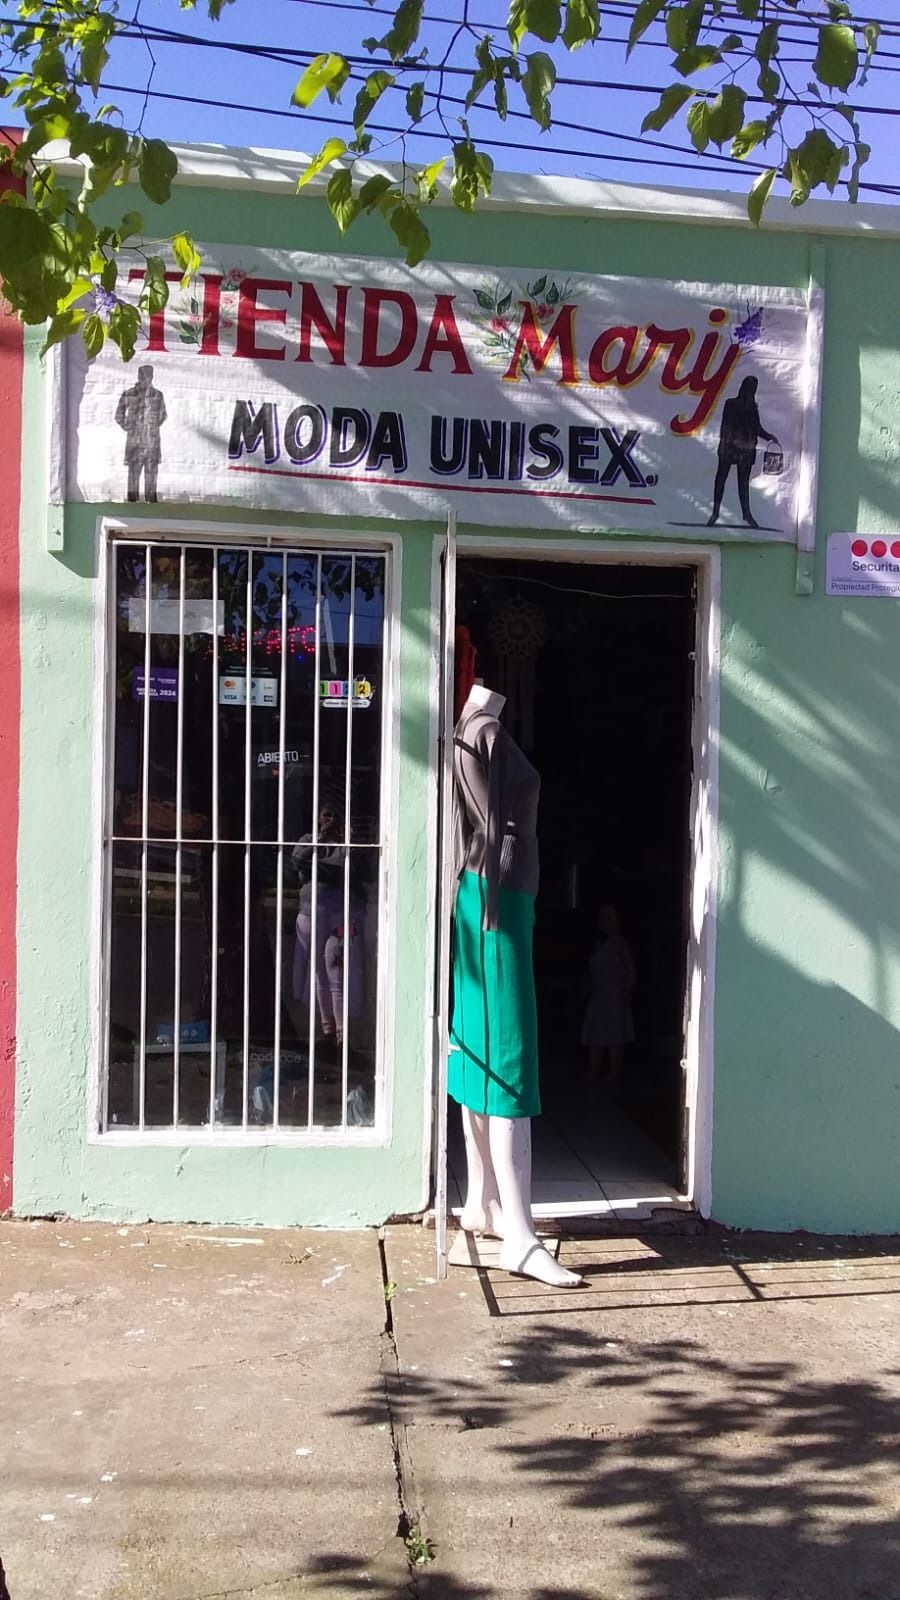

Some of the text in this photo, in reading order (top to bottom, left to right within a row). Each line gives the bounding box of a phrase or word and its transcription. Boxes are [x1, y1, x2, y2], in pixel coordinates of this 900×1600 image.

[128, 269, 473, 374] TIENDA
[228, 399, 658, 488] MODA UNISEX.
[832, 582, 869, 592] Propiedad
[852, 561, 900, 573] Securita
